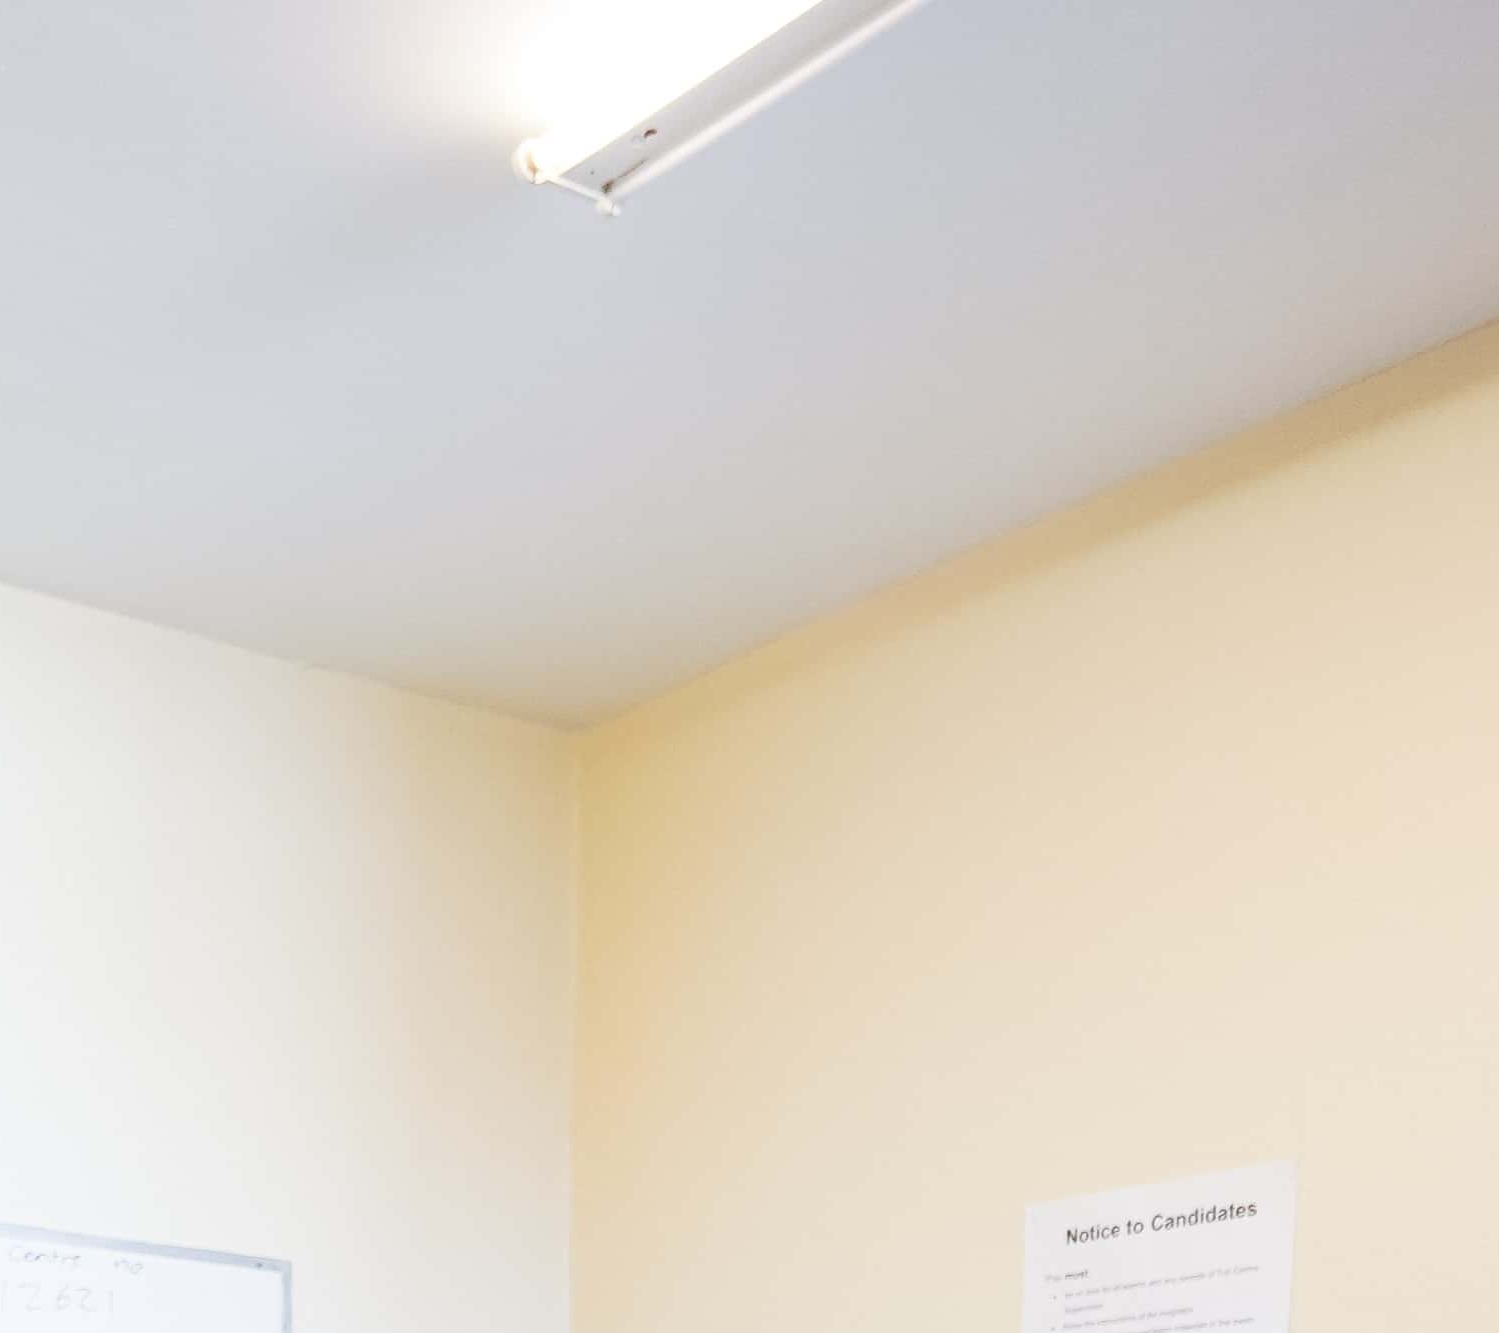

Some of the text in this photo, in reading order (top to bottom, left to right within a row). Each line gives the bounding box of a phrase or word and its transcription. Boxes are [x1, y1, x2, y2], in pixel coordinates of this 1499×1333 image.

[1066, 1202, 1257, 1245] Notice to Candidates
